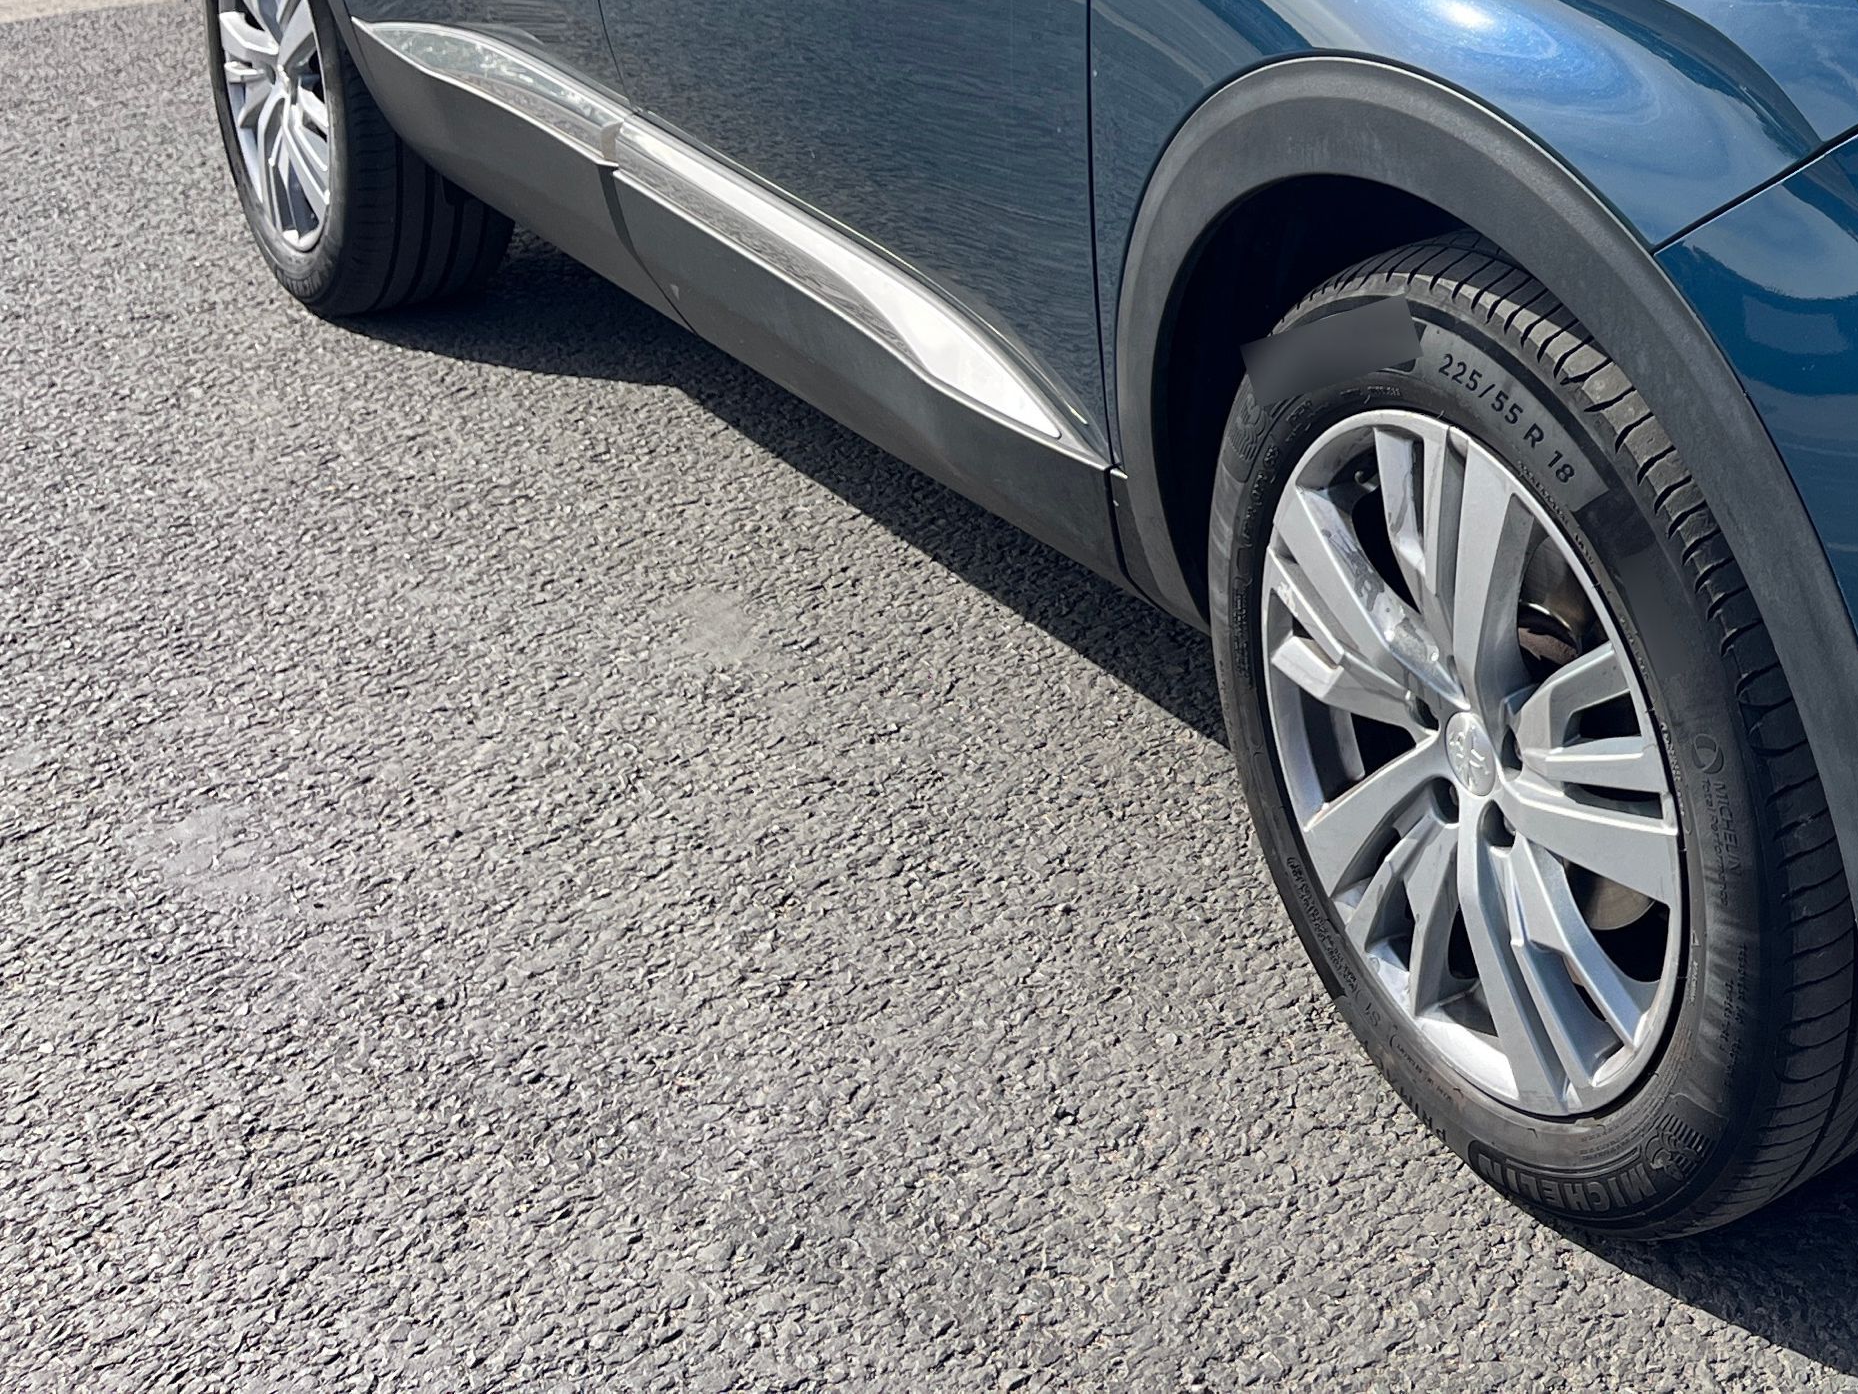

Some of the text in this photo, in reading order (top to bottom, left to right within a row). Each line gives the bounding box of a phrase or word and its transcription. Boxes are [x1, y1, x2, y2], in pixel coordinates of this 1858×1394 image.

[1438, 353, 1524, 425] 225/55
[1523, 423, 1545, 449] R
[1548, 450, 1575, 484] 18
[1713, 781, 1742, 878] MICHELIN
[1478, 1153, 1657, 1212] MICHELIN
